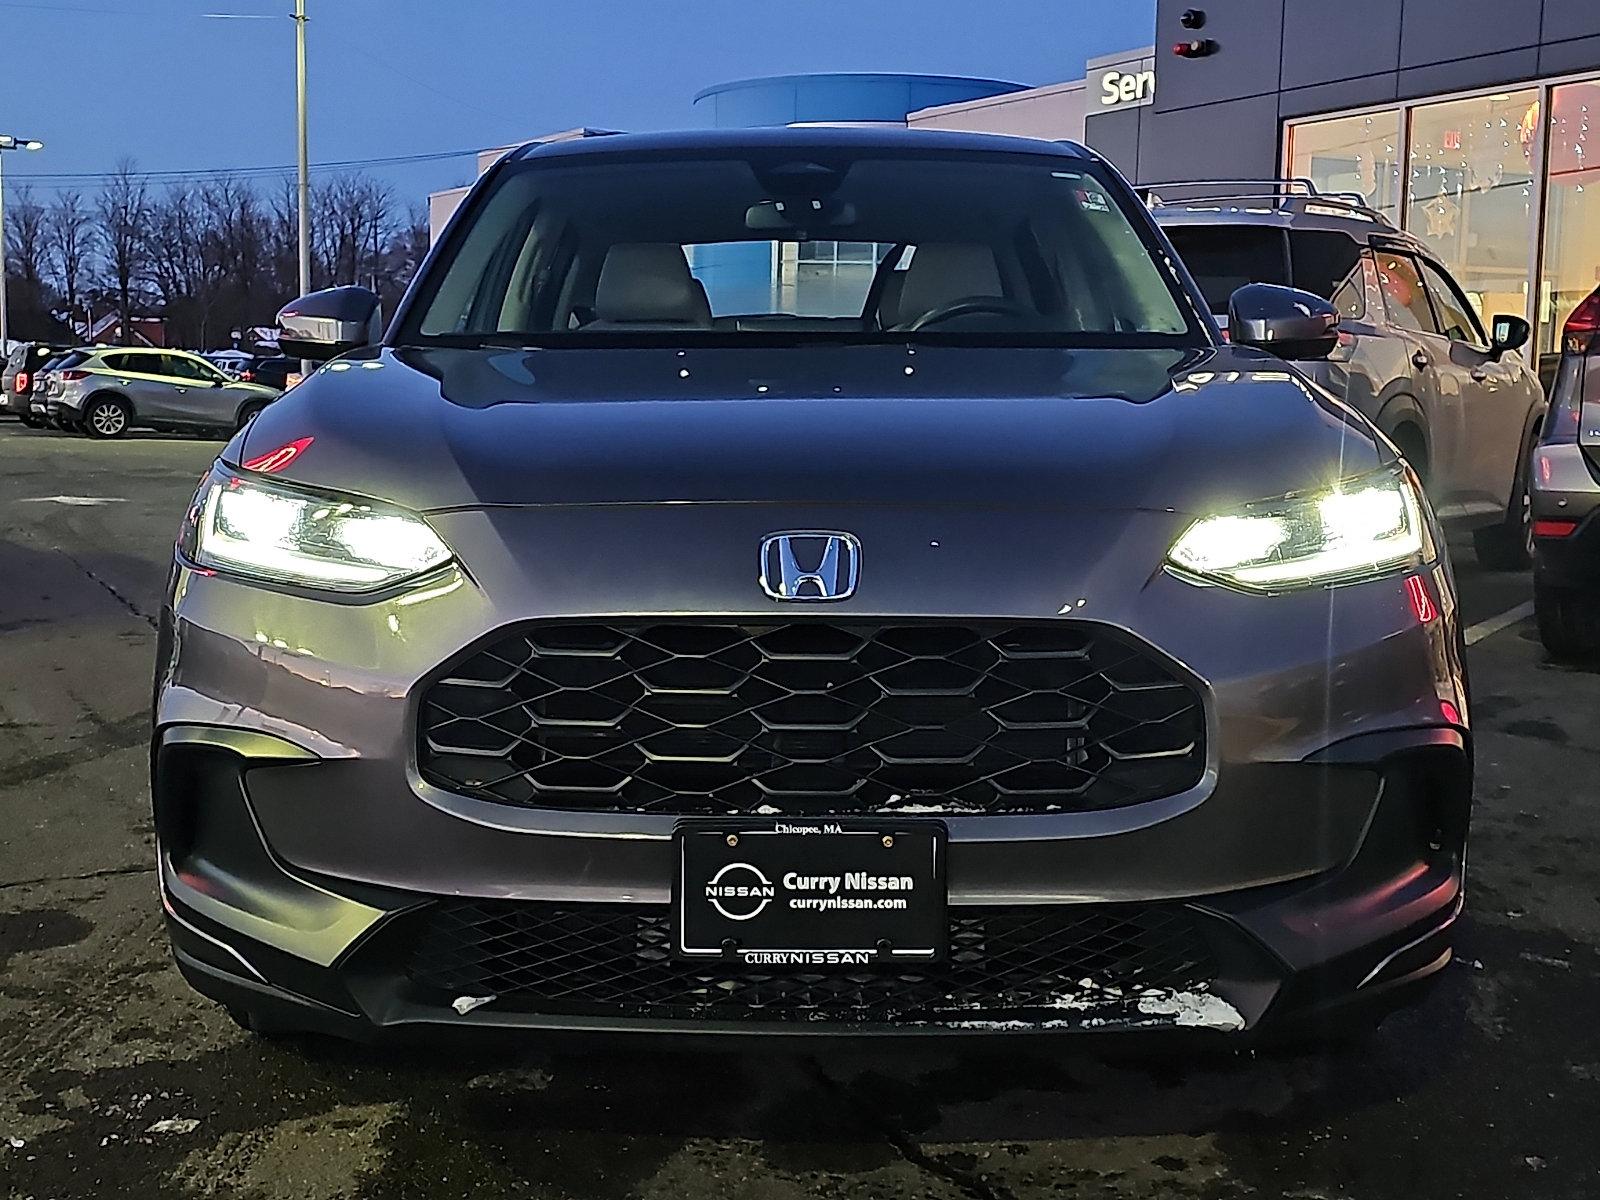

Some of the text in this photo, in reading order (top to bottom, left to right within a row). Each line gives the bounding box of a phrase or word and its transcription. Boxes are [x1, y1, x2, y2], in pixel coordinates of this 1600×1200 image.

[824, 823, 843, 834] MA
[783, 872, 914, 895] Curry Nissan
[706, 886, 774, 897] NISSAN
[789, 896, 907, 912] currynissan.com
